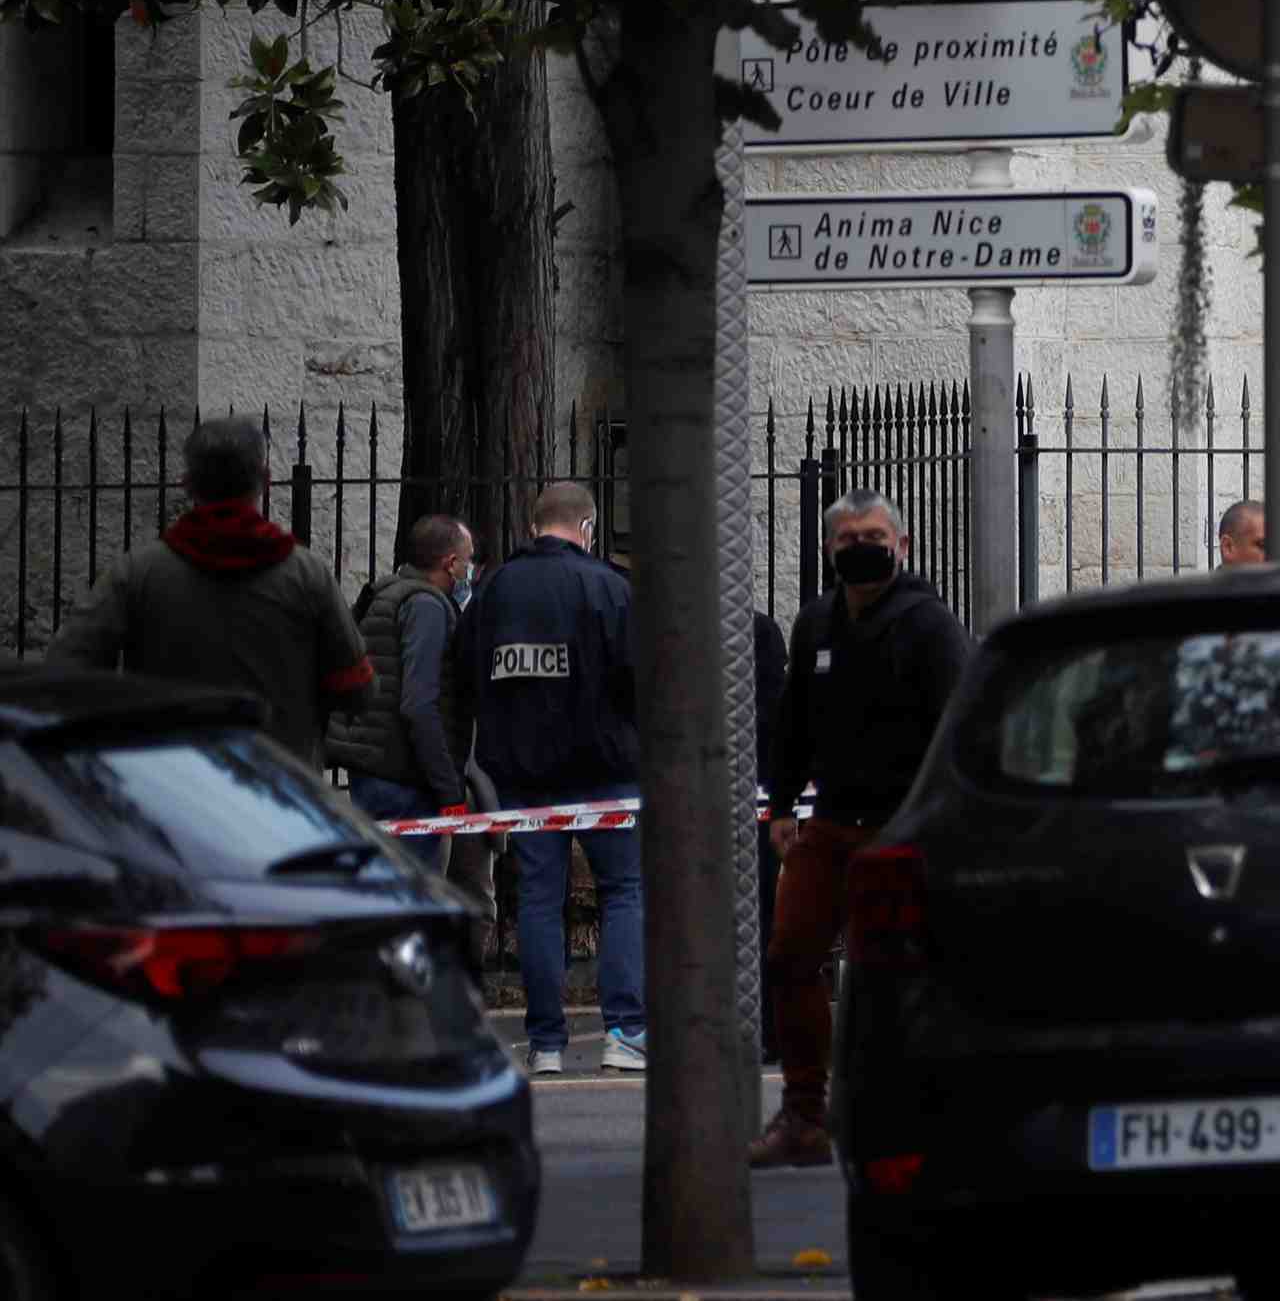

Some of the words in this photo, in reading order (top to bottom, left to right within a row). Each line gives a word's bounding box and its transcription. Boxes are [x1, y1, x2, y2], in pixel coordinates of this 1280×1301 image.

[913, 30, 1059, 67] proximité
[786, 84, 876, 112] Coeur
[891, 82, 925, 110] de
[943, 79, 1011, 107] Ville
[814, 211, 913, 239] Anima
[932, 209, 1002, 236] Nice
[814, 244, 849, 271] de
[868, 241, 1062, 270] Notre-Dame
[493, 647, 567, 675] POLICE
